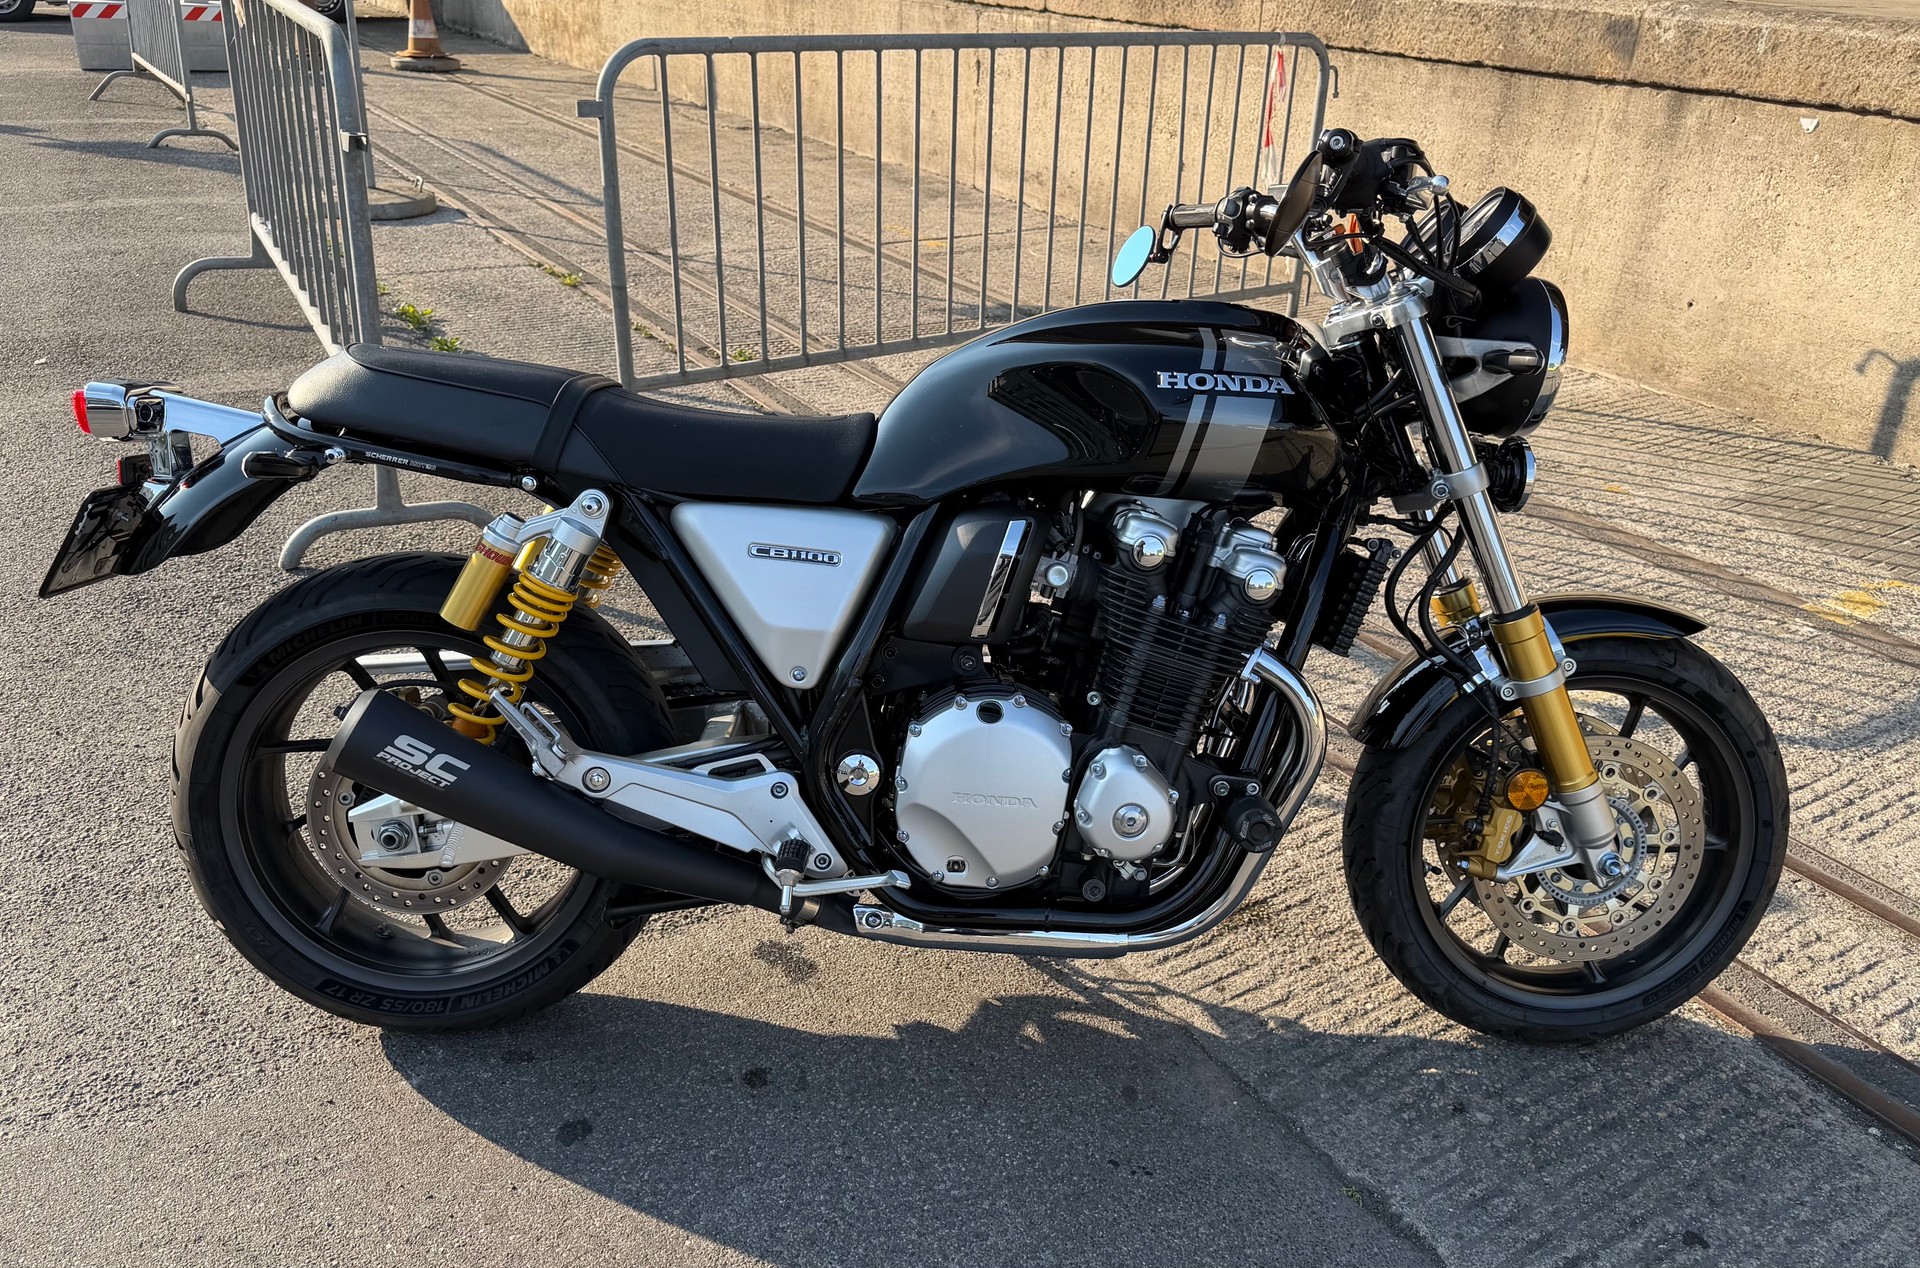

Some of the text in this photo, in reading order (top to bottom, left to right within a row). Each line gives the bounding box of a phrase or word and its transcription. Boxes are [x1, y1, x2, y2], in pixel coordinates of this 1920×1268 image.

[1156, 371, 1295, 395] HONDA
[365, 451, 409, 466] SCHERRER
[750, 545, 839, 563] CB1100
[269, 615, 363, 665] MICHELIN
[376, 751, 451, 787] PROJECT
[383, 734, 471, 783] SC
[952, 791, 1037, 808] HONDA
[1702, 914, 1742, 964] MICHELIN
[323, 958, 552, 1014] MICHELIN 180/55 ZR 17
